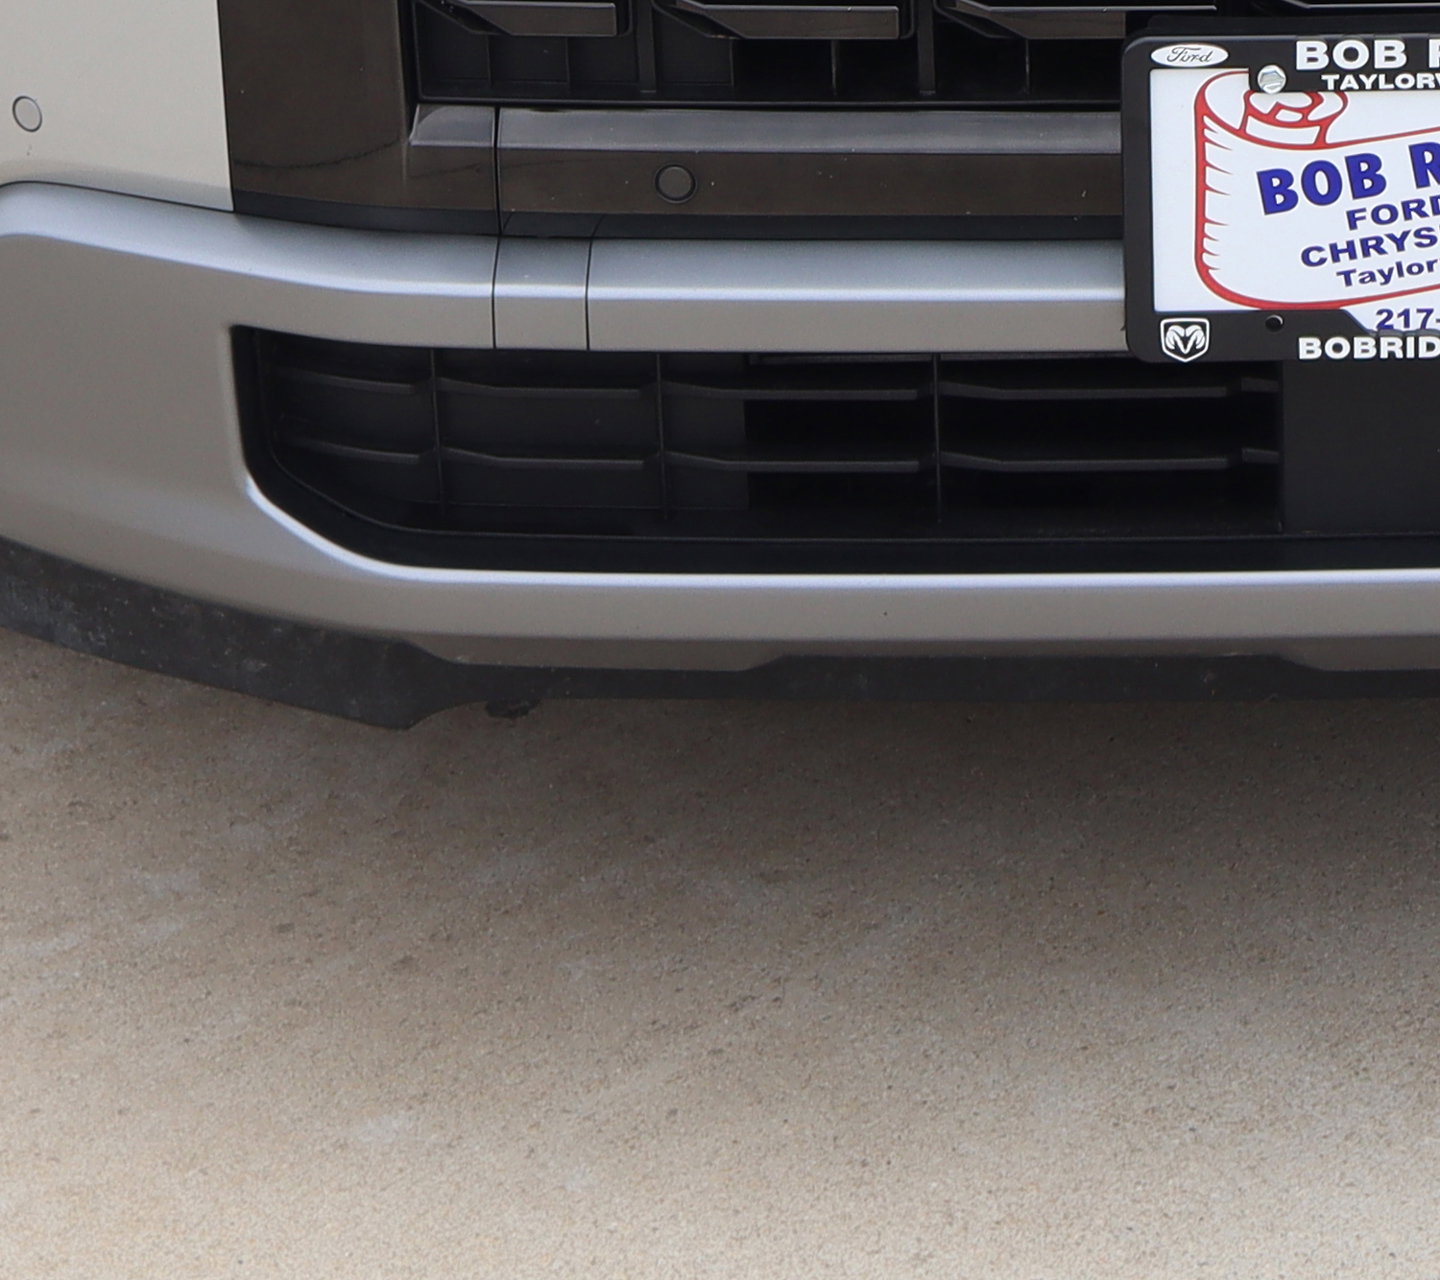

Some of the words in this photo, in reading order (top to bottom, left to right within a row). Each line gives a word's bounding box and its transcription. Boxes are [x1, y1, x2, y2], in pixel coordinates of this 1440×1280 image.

[1166, 45, 1214, 64] Ford
[1295, 38, 1408, 71] BOB
[1256, 152, 1388, 216] BOB
